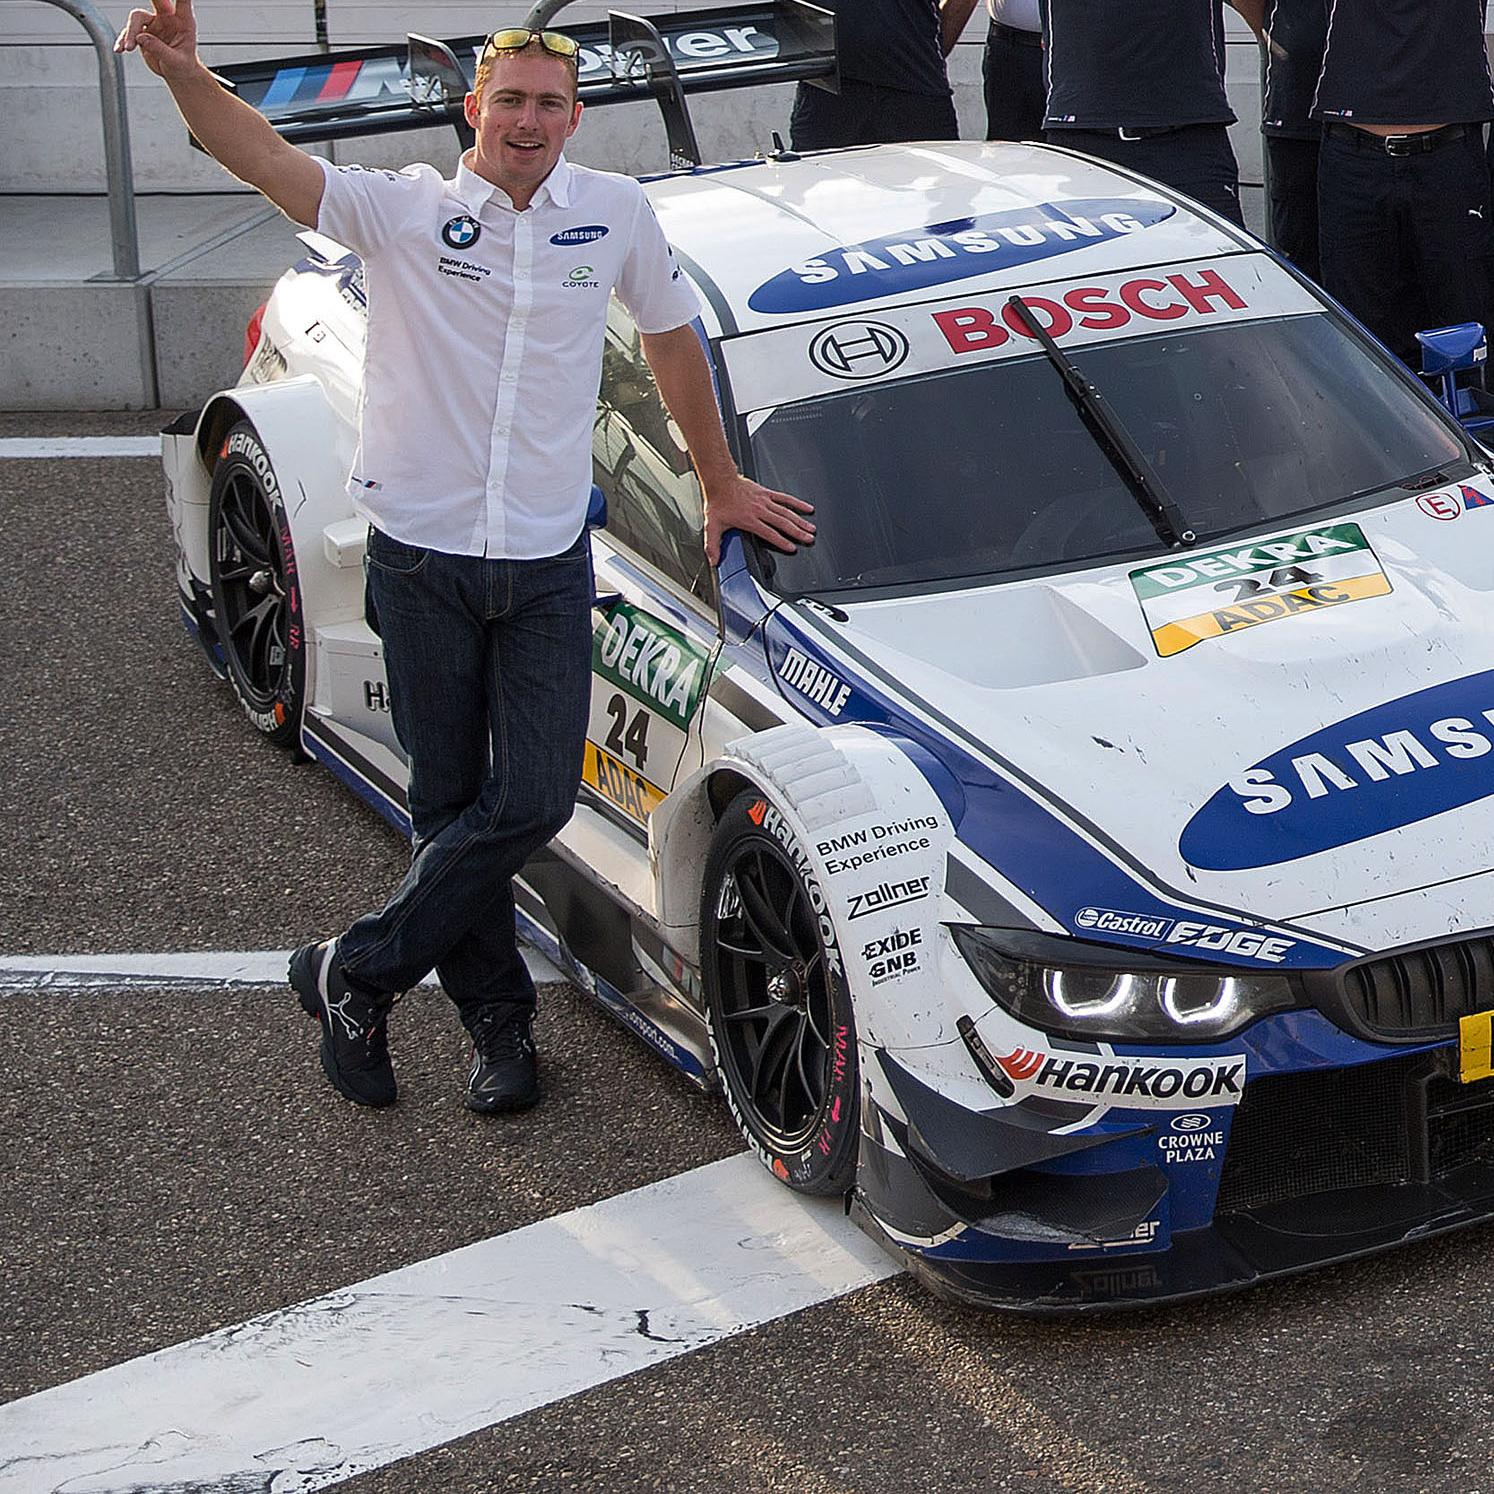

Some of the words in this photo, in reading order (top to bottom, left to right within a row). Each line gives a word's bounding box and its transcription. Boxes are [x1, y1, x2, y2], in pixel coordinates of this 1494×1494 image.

[557, 227, 603, 242] SAMSUNG
[800, 211, 1144, 285] SAMSUNG
[438, 265, 481, 282] Experience
[440, 257, 462, 269] BMW
[461, 262, 491, 276] Driving
[562, 280, 600, 289] COYOTE
[931, 270, 1248, 355] BOSCH
[1142, 526, 1358, 590] DEKRA
[1212, 567, 1326, 603] 24
[1212, 584, 1354, 637] ADAC
[601, 613, 699, 719] DEKRA
[779, 646, 852, 716] MAHLE
[605, 693, 649, 772] 24
[816, 832, 870, 859] BMW
[871, 814, 939, 847] Driving
[825, 836, 932, 876] Experience
[861, 927, 922, 961] EXIDE
[1098, 910, 1167, 940] Castrol
[1168, 921, 1297, 964] EDGE
[869, 951, 917, 978] GNB
[1158, 1131, 1223, 1150] CROWNE
[1166, 1147, 1215, 1164] PLAZA
